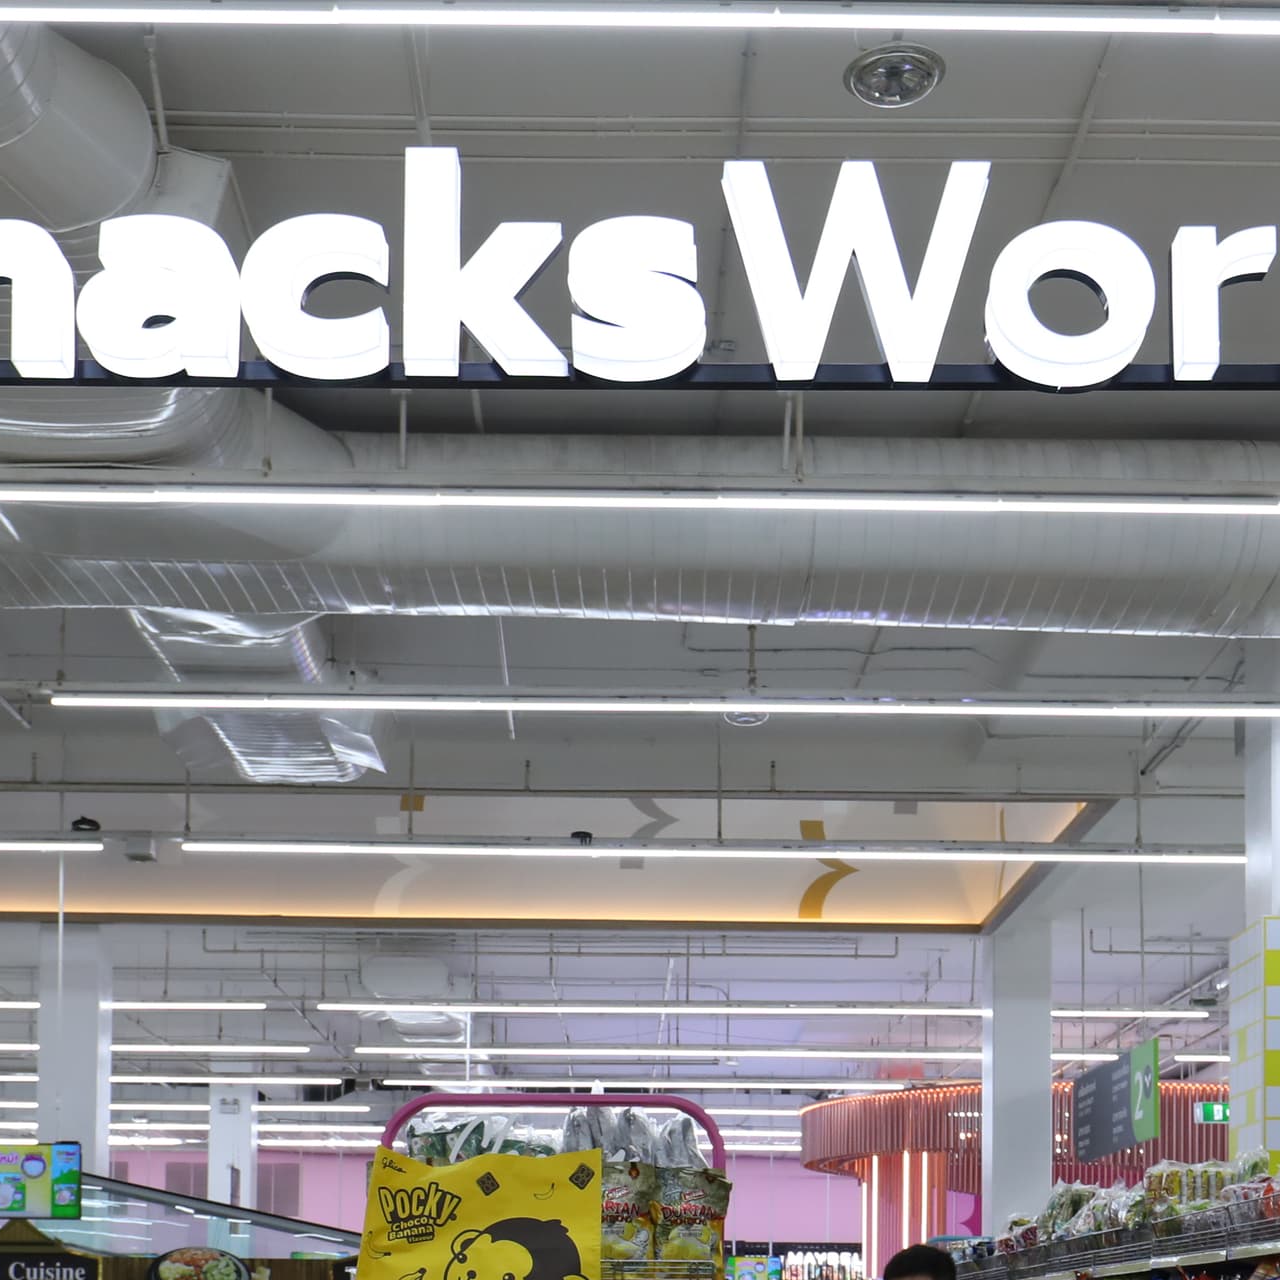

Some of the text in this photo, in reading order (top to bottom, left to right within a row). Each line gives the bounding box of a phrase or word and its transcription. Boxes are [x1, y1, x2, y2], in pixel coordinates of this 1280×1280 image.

[661, 1203, 717, 1220] DURIAN
[392, 1216, 431, 1231] Choco
[389, 1226, 433, 1241] Banana
[8, 1261, 86, 1280] Cuisine
